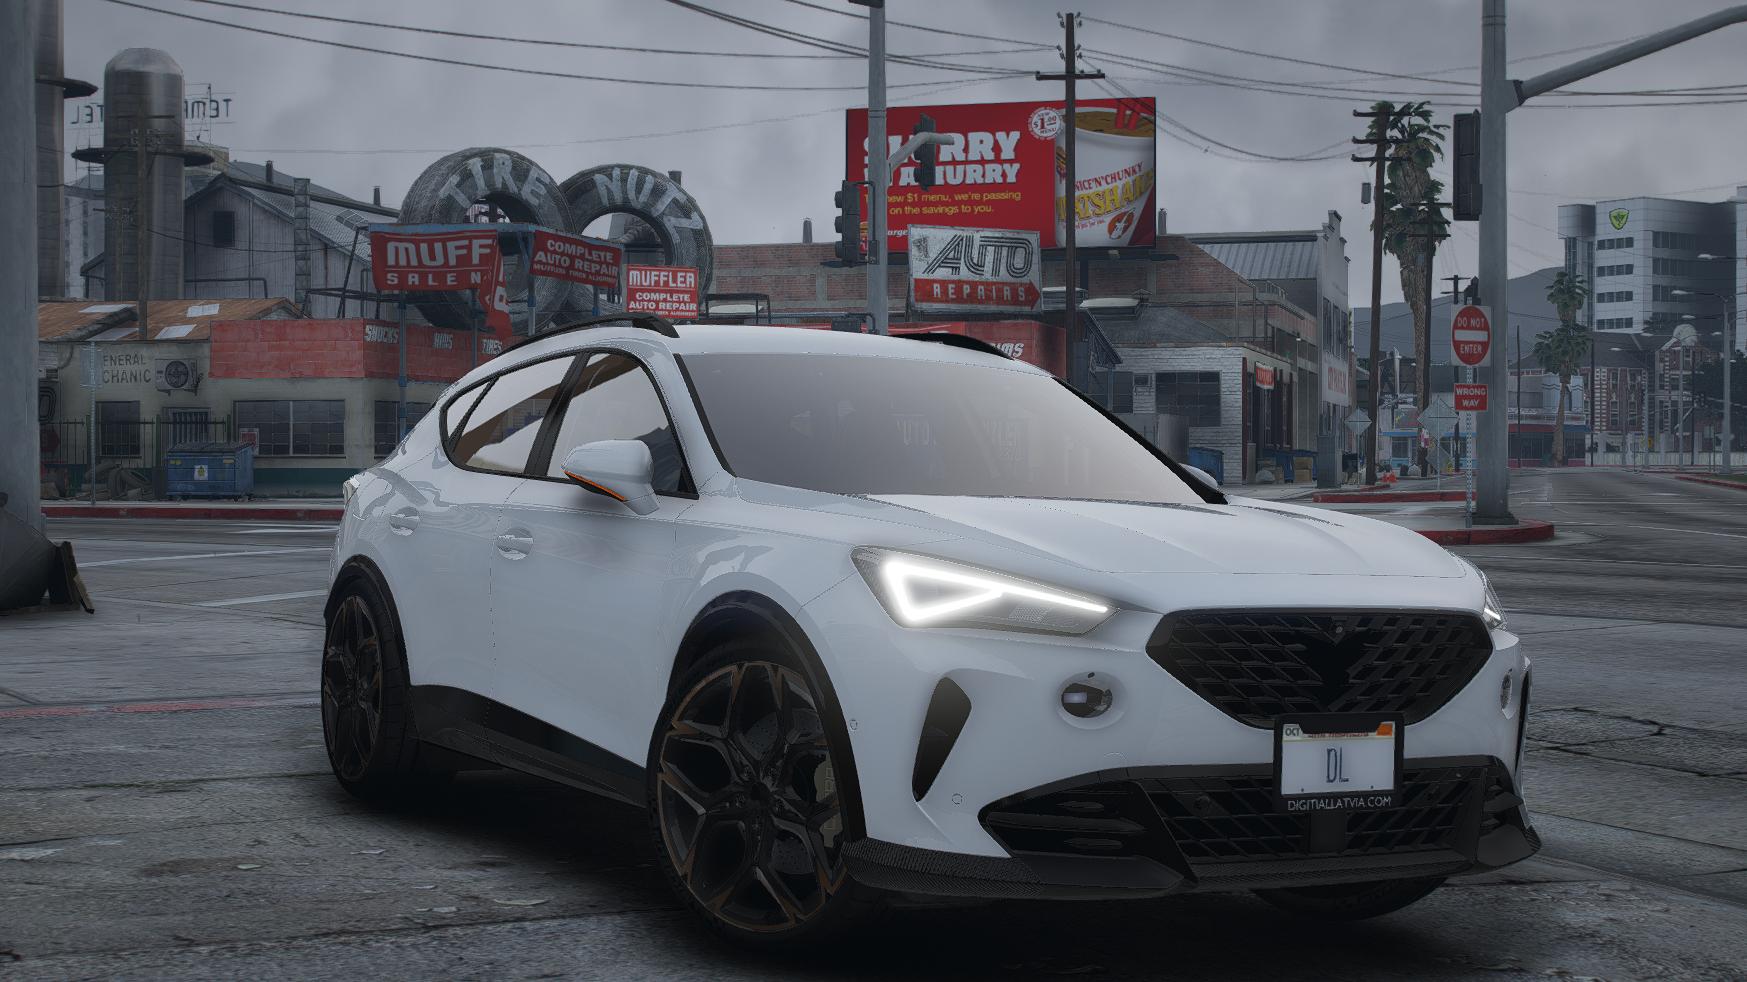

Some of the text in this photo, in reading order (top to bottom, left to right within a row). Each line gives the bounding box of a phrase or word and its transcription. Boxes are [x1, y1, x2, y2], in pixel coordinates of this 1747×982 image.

[439, 153, 551, 208] TIRE
[906, 192, 918, 203] $1
[921, 194, 952, 204] menu,
[954, 191, 981, 201] we're
[983, 190, 1022, 203] passing
[593, 167, 704, 244] NUTZ
[904, 205, 920, 214] the
[921, 204, 959, 217] savings
[961, 204, 971, 213] to
[386, 239, 493, 267] MUFF
[547, 239, 615, 264] COMPLETE
[922, 234, 1034, 279] AUTO
[534, 250, 619, 277] AUTO REPAIR
[386, 272, 458, 286] SALE
[629, 270, 695, 288] MUFFLER
[635, 292, 691, 302] COMPLETE
[933, 283, 1026, 301] REPAIRS
[628, 301, 697, 311] AUTO REPAIR
[1457, 317, 1485, 327] DO NOT
[1459, 344, 1483, 354] ENTER
[103, 352, 147, 367] ENERAL
[102, 369, 152, 384] CHANIC
[1455, 387, 1487, 396] WRONG
[1461, 399, 1480, 408] WAY
[1284, 727, 1301, 737] OCT
[1326, 746, 1350, 784] DL
